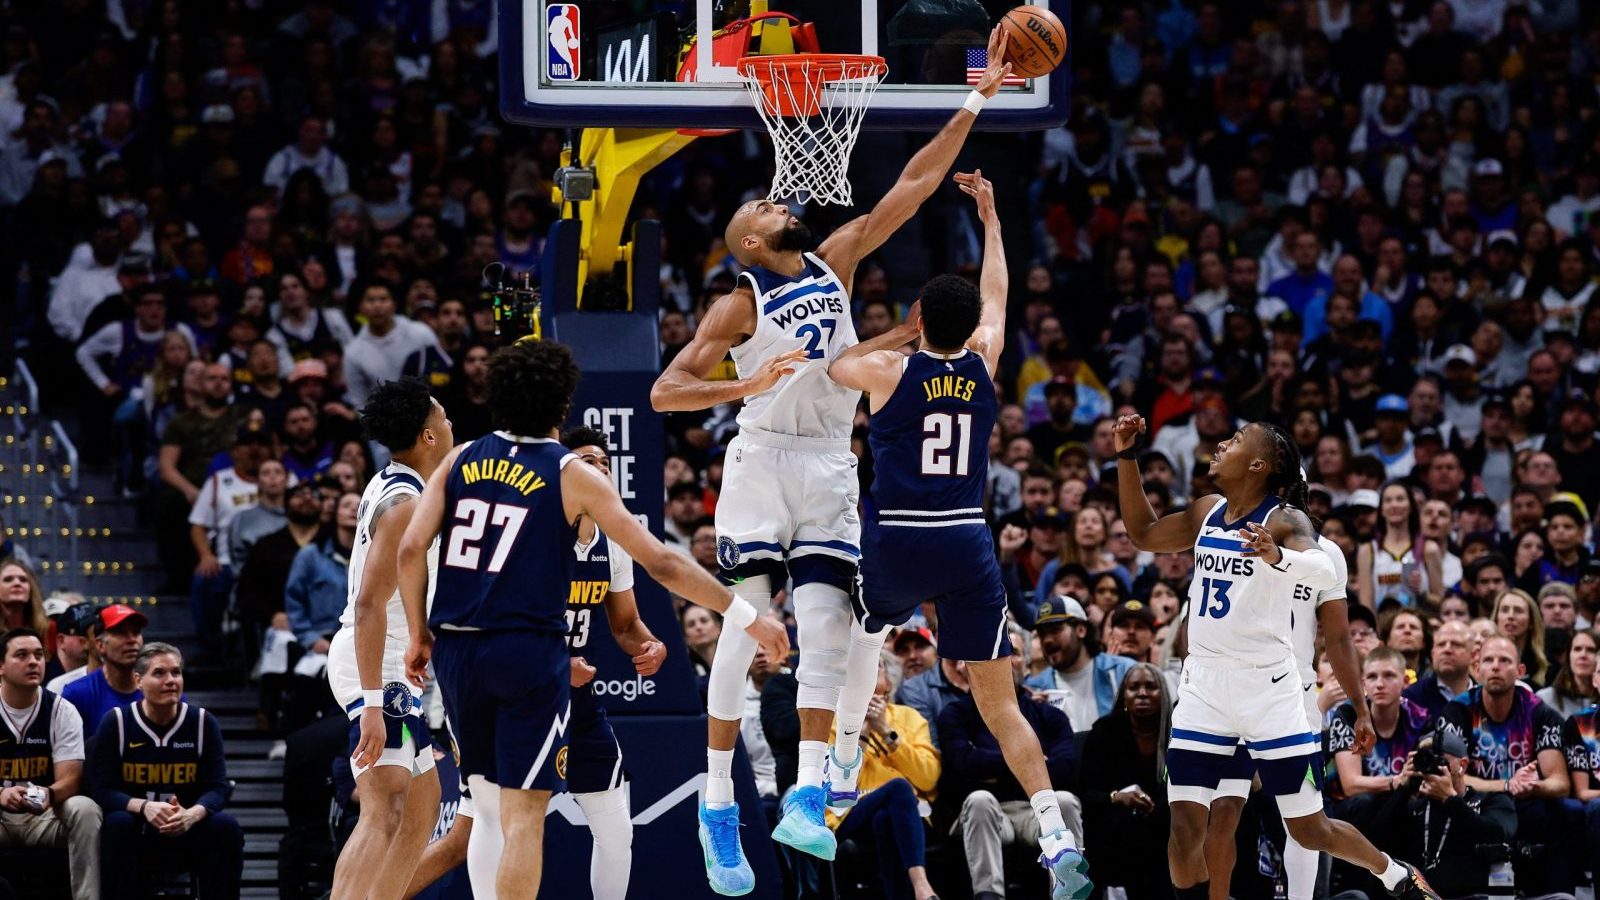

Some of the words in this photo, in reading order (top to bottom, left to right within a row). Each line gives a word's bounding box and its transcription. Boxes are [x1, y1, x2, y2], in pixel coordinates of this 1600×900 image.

[1027, 16, 1060, 59] Wilson
[551, 63, 568, 76] NBA
[771, 297, 843, 330] WOLVES
[795, 318, 837, 360] 27
[923, 375, 976, 402] JONES
[921, 412, 972, 476] 21
[461, 458, 546, 496] MURRAY
[445, 498, 529, 573] 27
[591, 554, 608, 562] ibotta
[1195, 552, 1254, 577] WOLVES
[567, 580, 610, 604] NVER
[1198, 577, 1233, 619] 13
[1293, 583, 1313, 601] ES
[593, 674, 656, 701] oogle
[122, 762, 197, 784] DENVER
